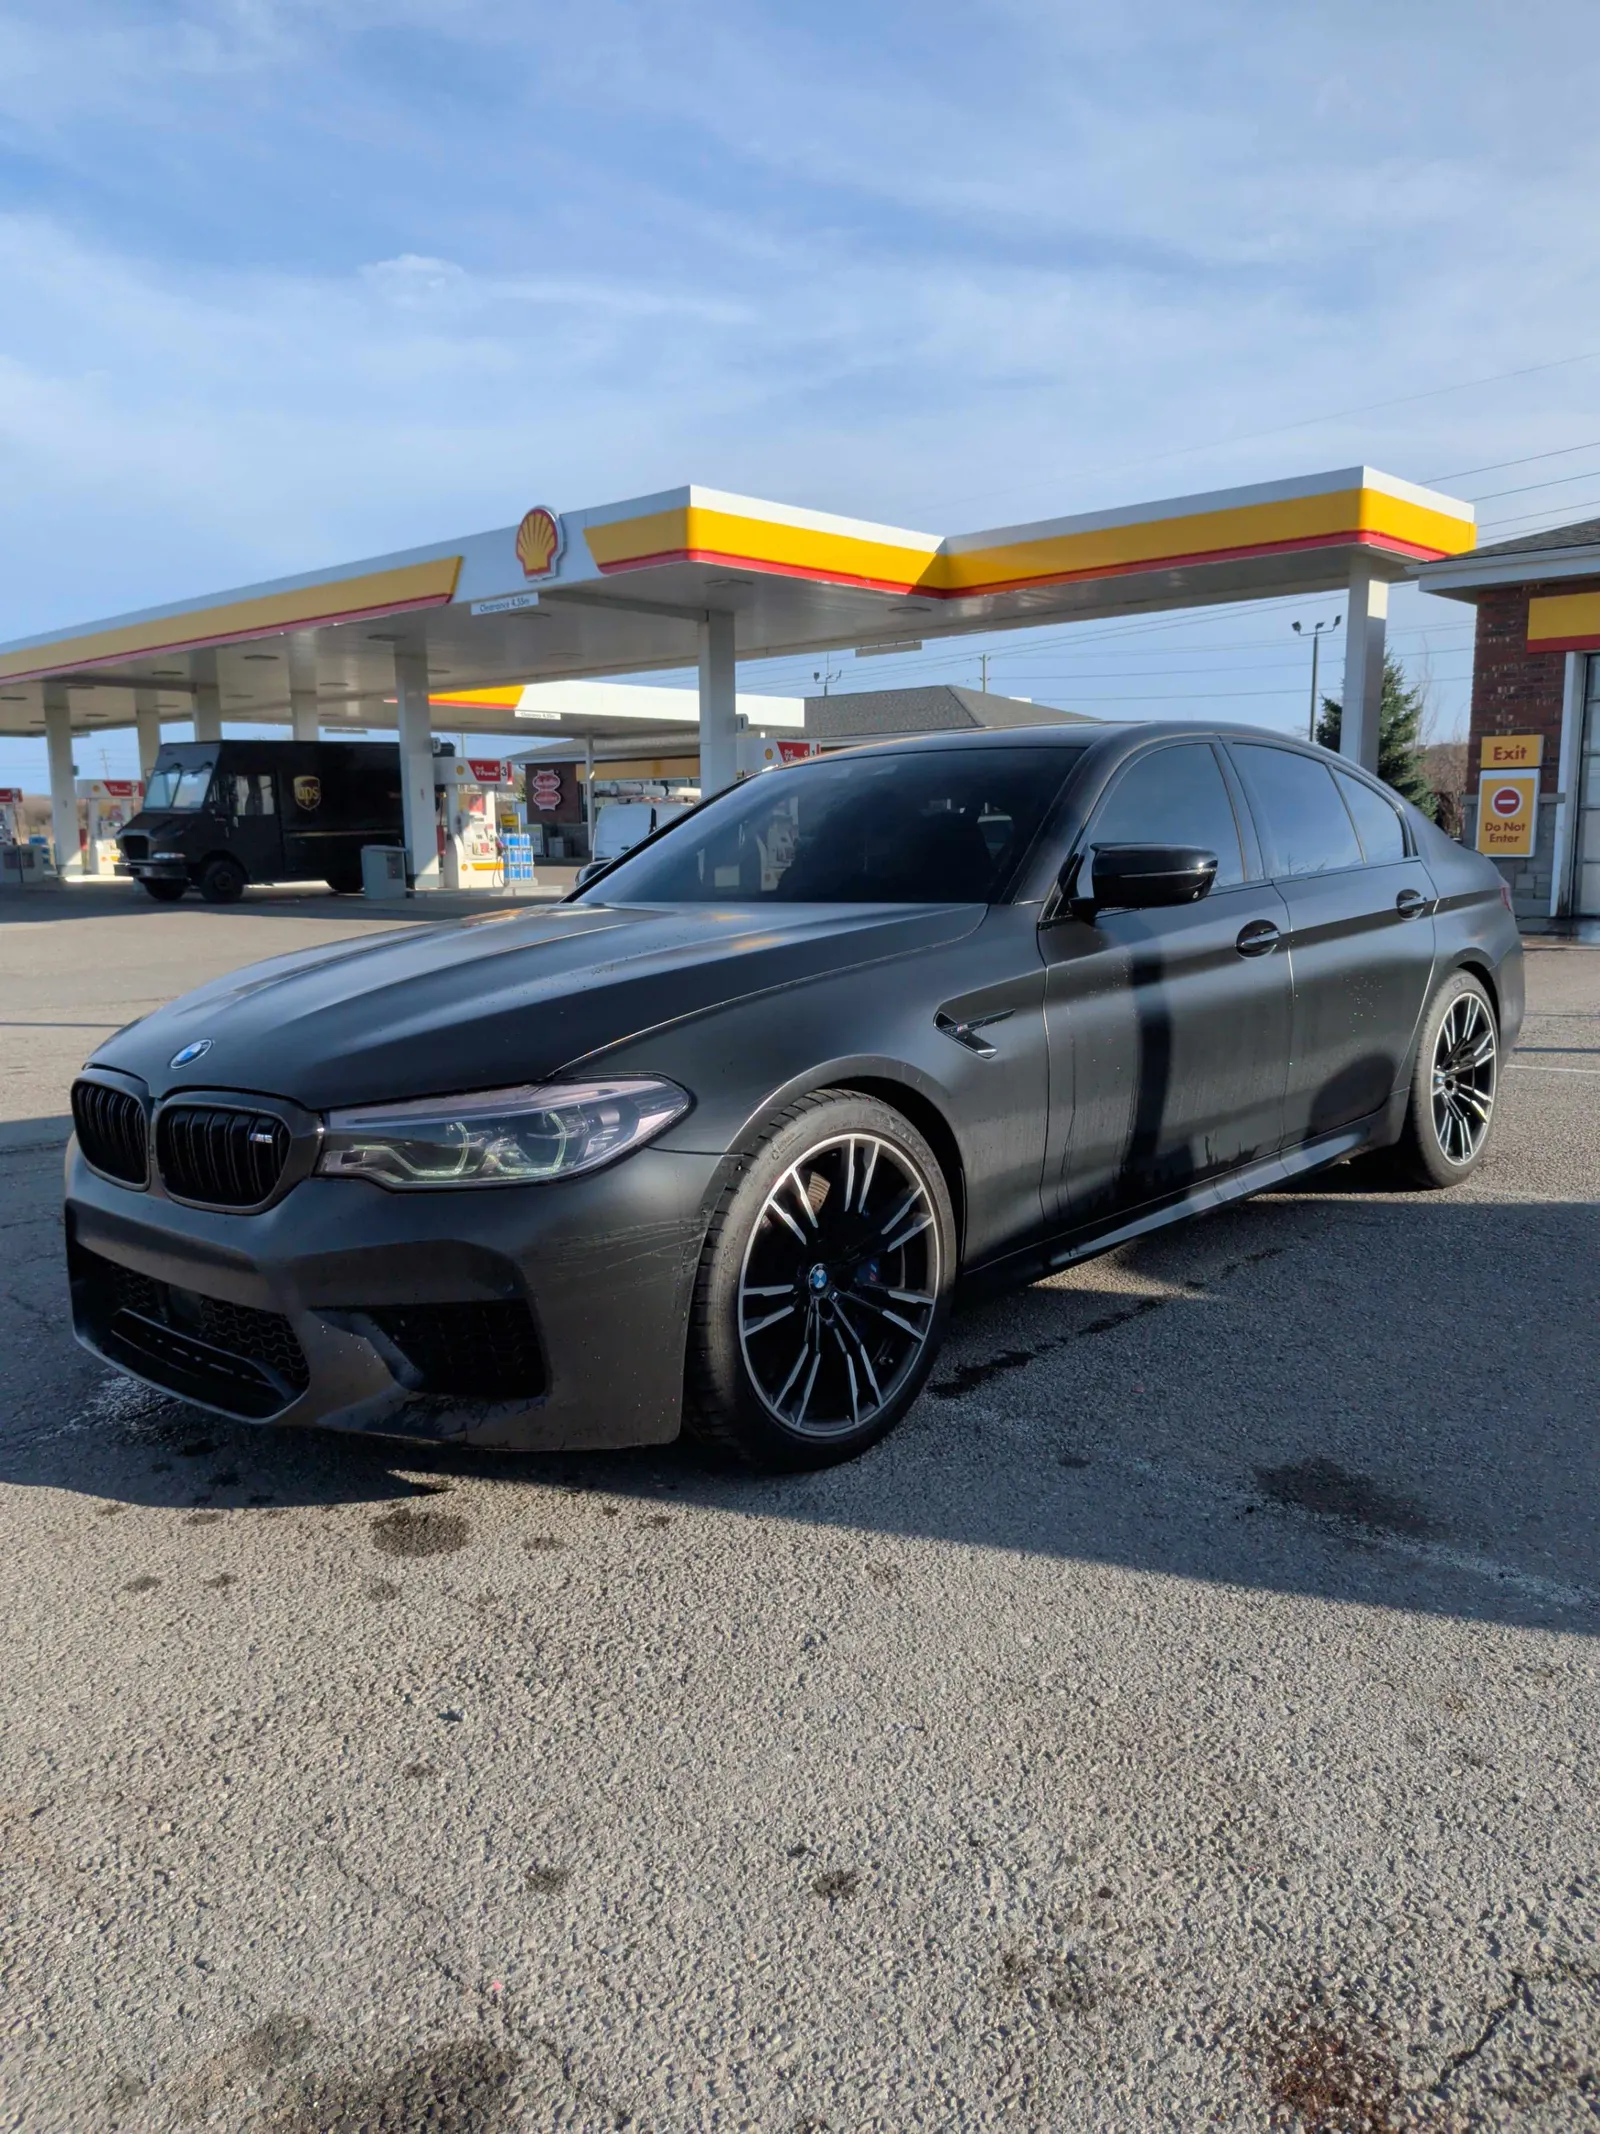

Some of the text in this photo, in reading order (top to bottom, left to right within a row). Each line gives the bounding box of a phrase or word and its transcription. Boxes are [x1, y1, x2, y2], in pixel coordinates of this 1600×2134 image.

[1493, 745, 1527, 761] Exit
[501, 766, 507, 776] 3
[1485, 822, 1526, 832] Do Not
[1489, 833, 1520, 843] Enter
